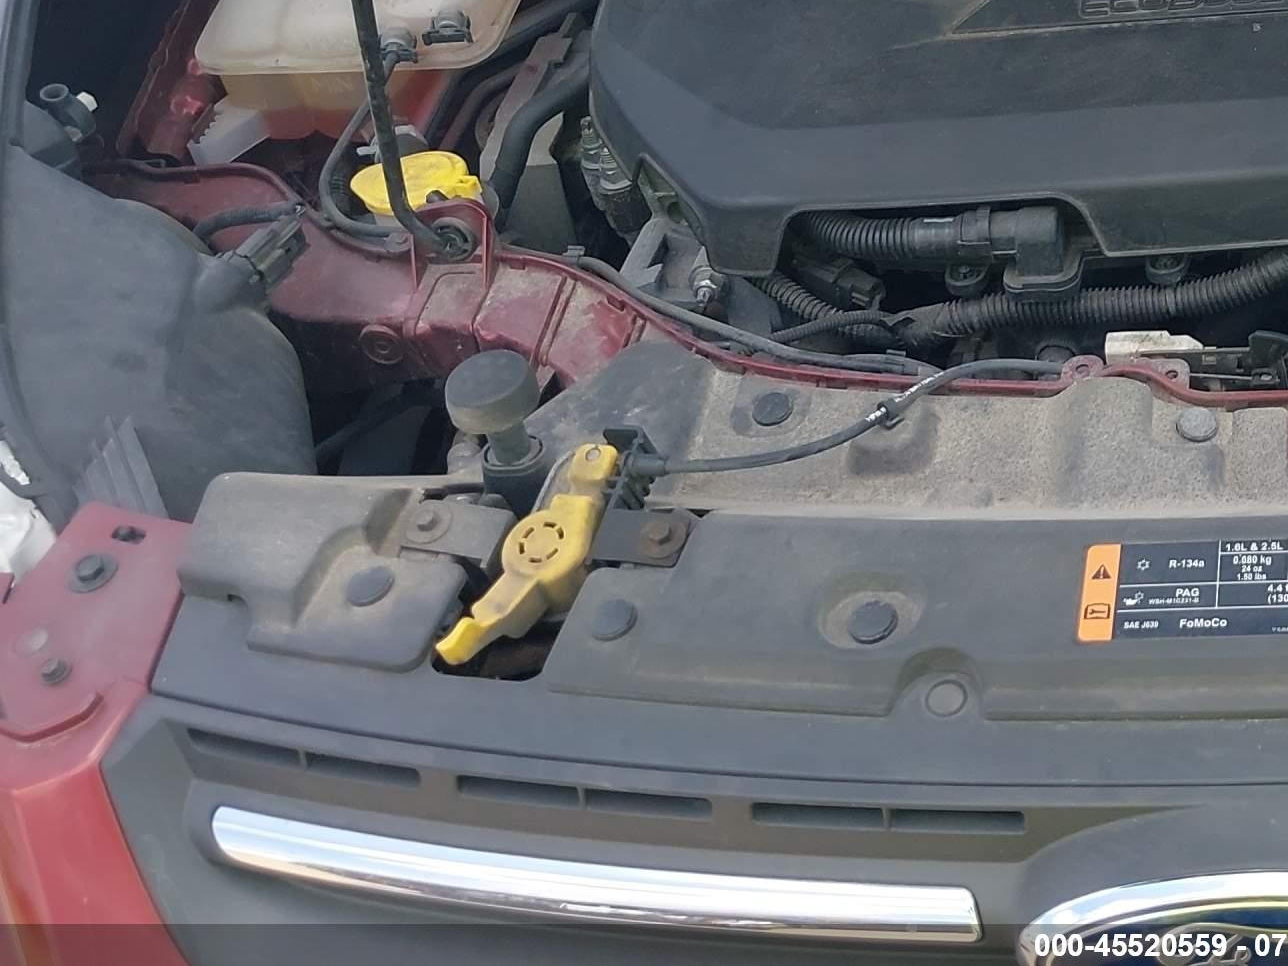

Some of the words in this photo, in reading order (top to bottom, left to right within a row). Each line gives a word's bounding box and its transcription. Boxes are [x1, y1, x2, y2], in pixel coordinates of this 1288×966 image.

[1250, 542, 1258, 551] &
[1168, 558, 1205, 569] R-134a
[1260, 554, 1272, 566] kg
[1241, 565, 1251, 573] 24
[1254, 571, 1267, 580] lbs
[1175, 588, 1200, 598] PAG
[1267, 584, 1283, 593] 4.4
[1267, 593, 1288, 604] (130
[1123, 620, 1140, 629] SAE
[1179, 617, 1228, 629] FoMoCo
